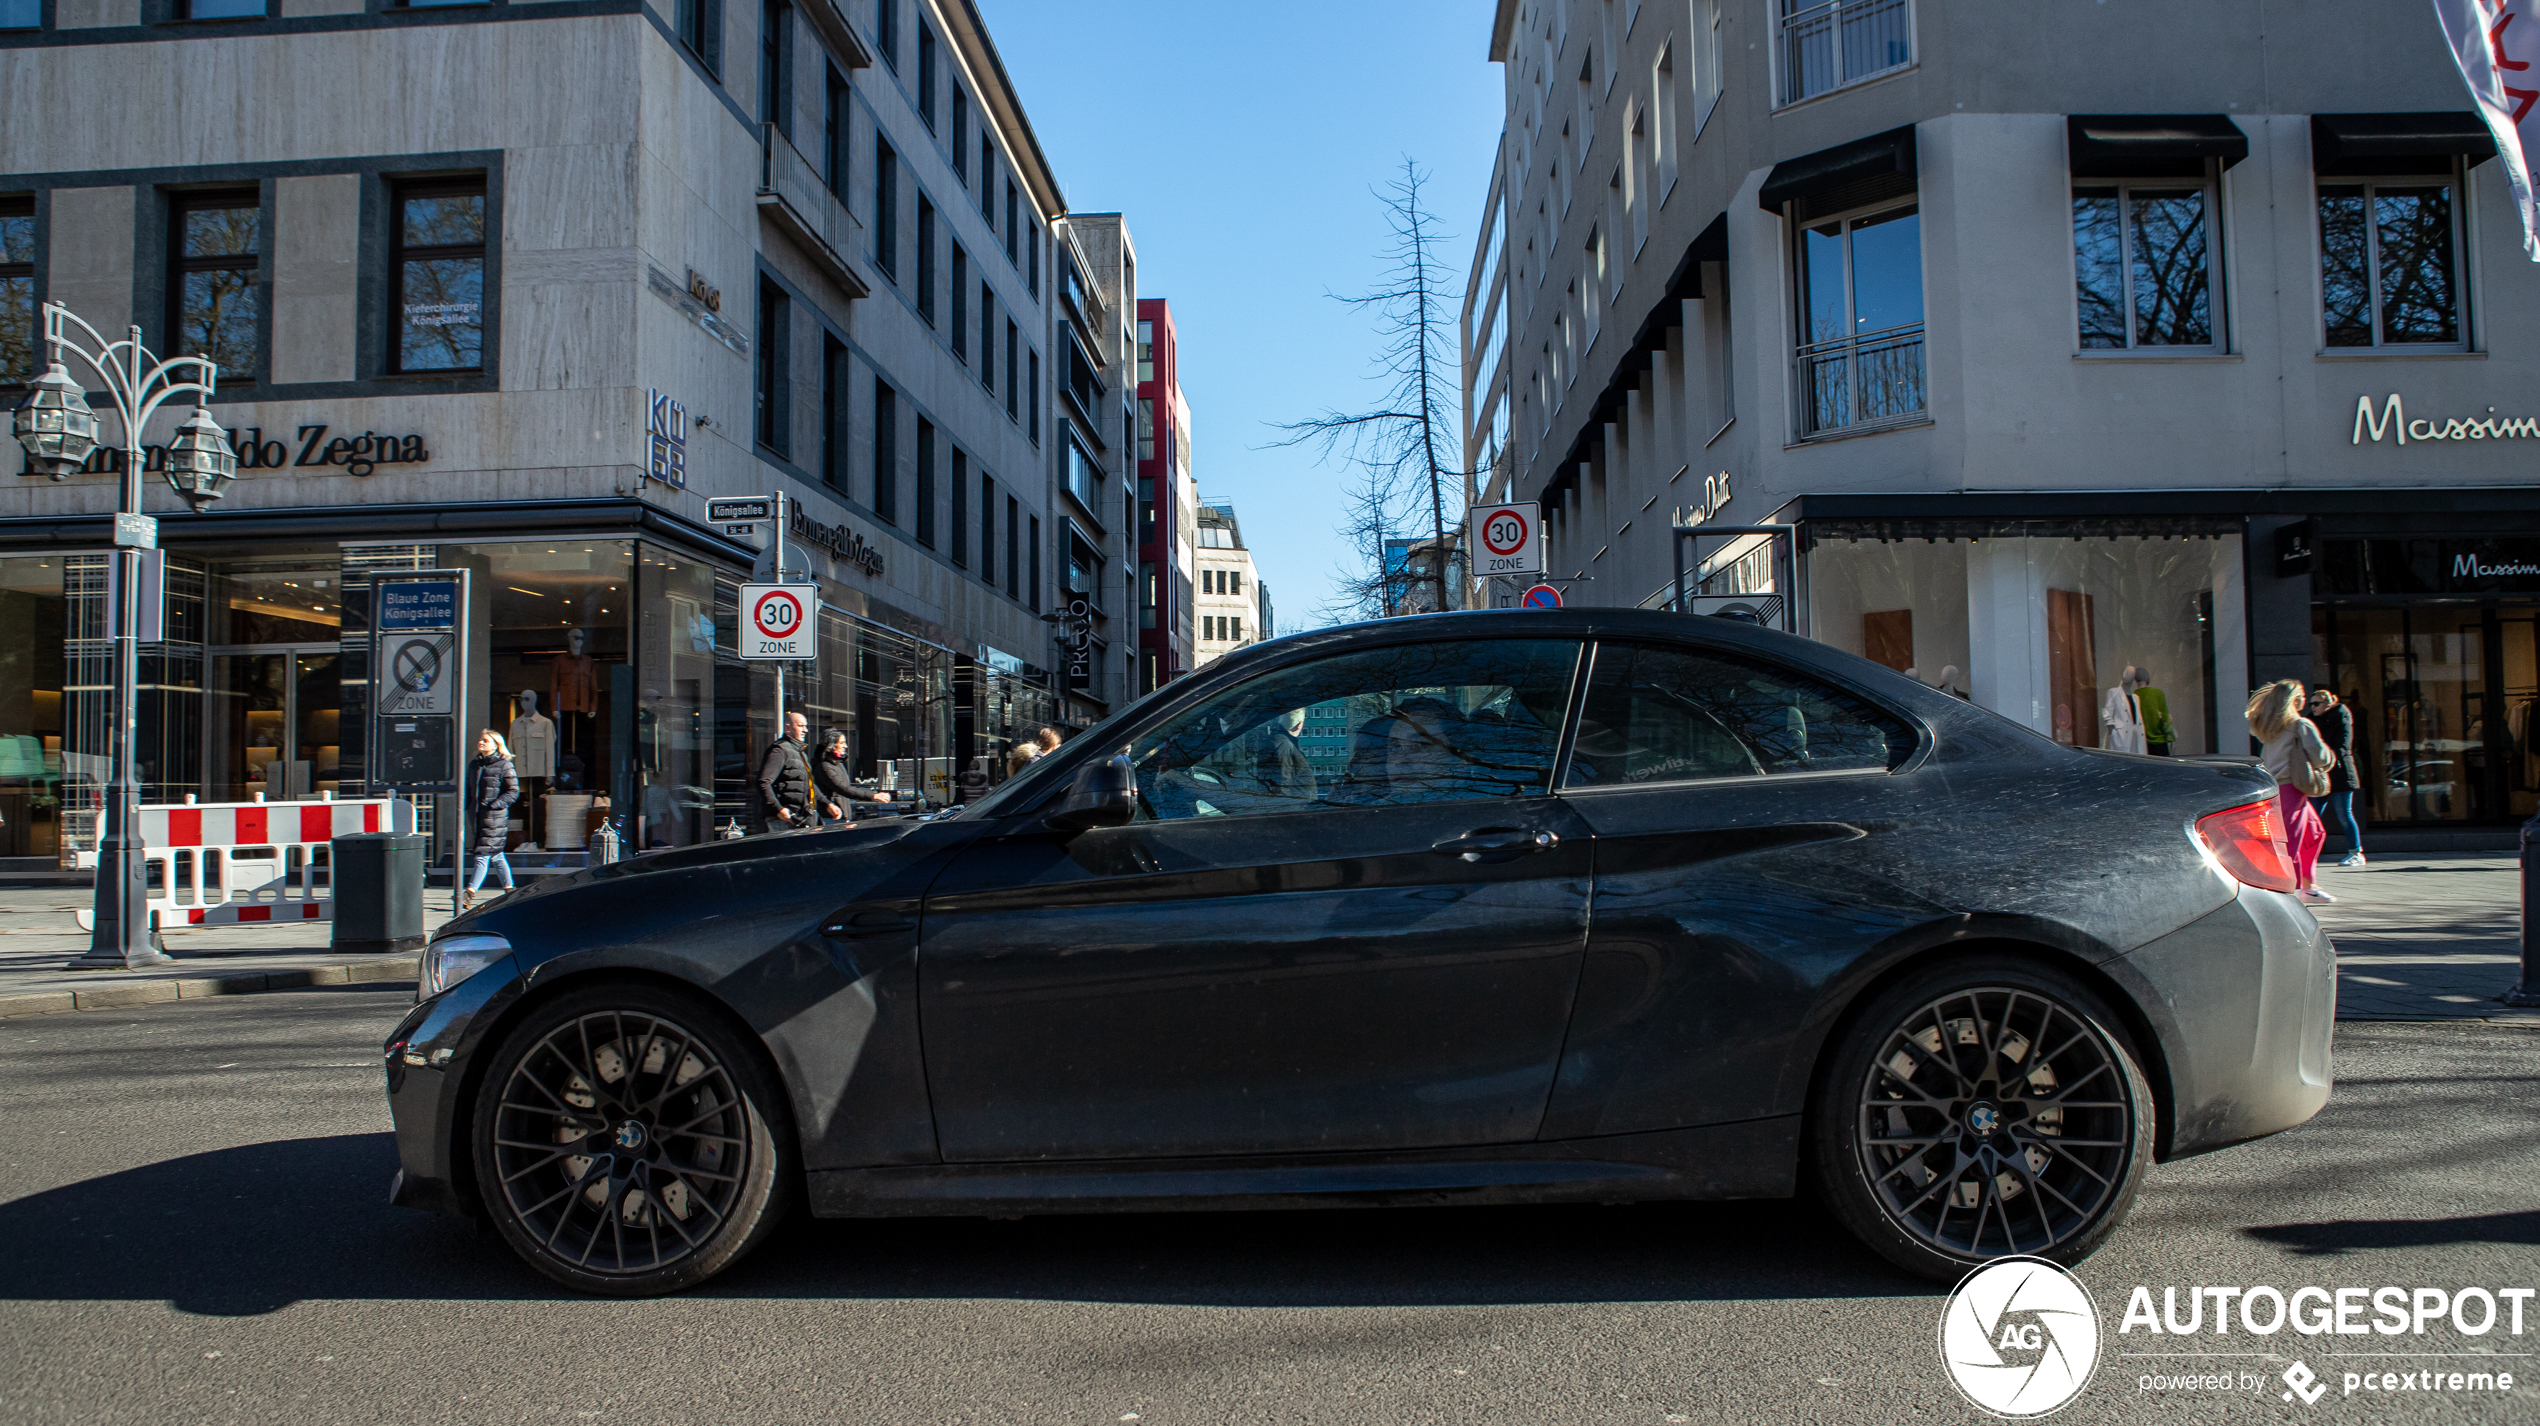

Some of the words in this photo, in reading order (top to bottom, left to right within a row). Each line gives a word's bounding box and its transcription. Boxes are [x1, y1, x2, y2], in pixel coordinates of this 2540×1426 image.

[404, 301, 478, 314] Kieferchirurgie
[411, 313, 470, 327] Königsallee
[294, 424, 429, 477] Zegna
[1704, 470, 1732, 519] Dutti
[714, 504, 764, 519] Königsallee
[1491, 521, 1519, 544] 30
[1489, 557, 1524, 571] ZONE
[386, 593, 419, 605] Blaue
[421, 591, 450, 604] Zone
[384, 606, 452, 621] Königsallee
[763, 603, 792, 626] 30
[759, 641, 797, 654] ZONE
[397, 696, 436, 710] ZONE
